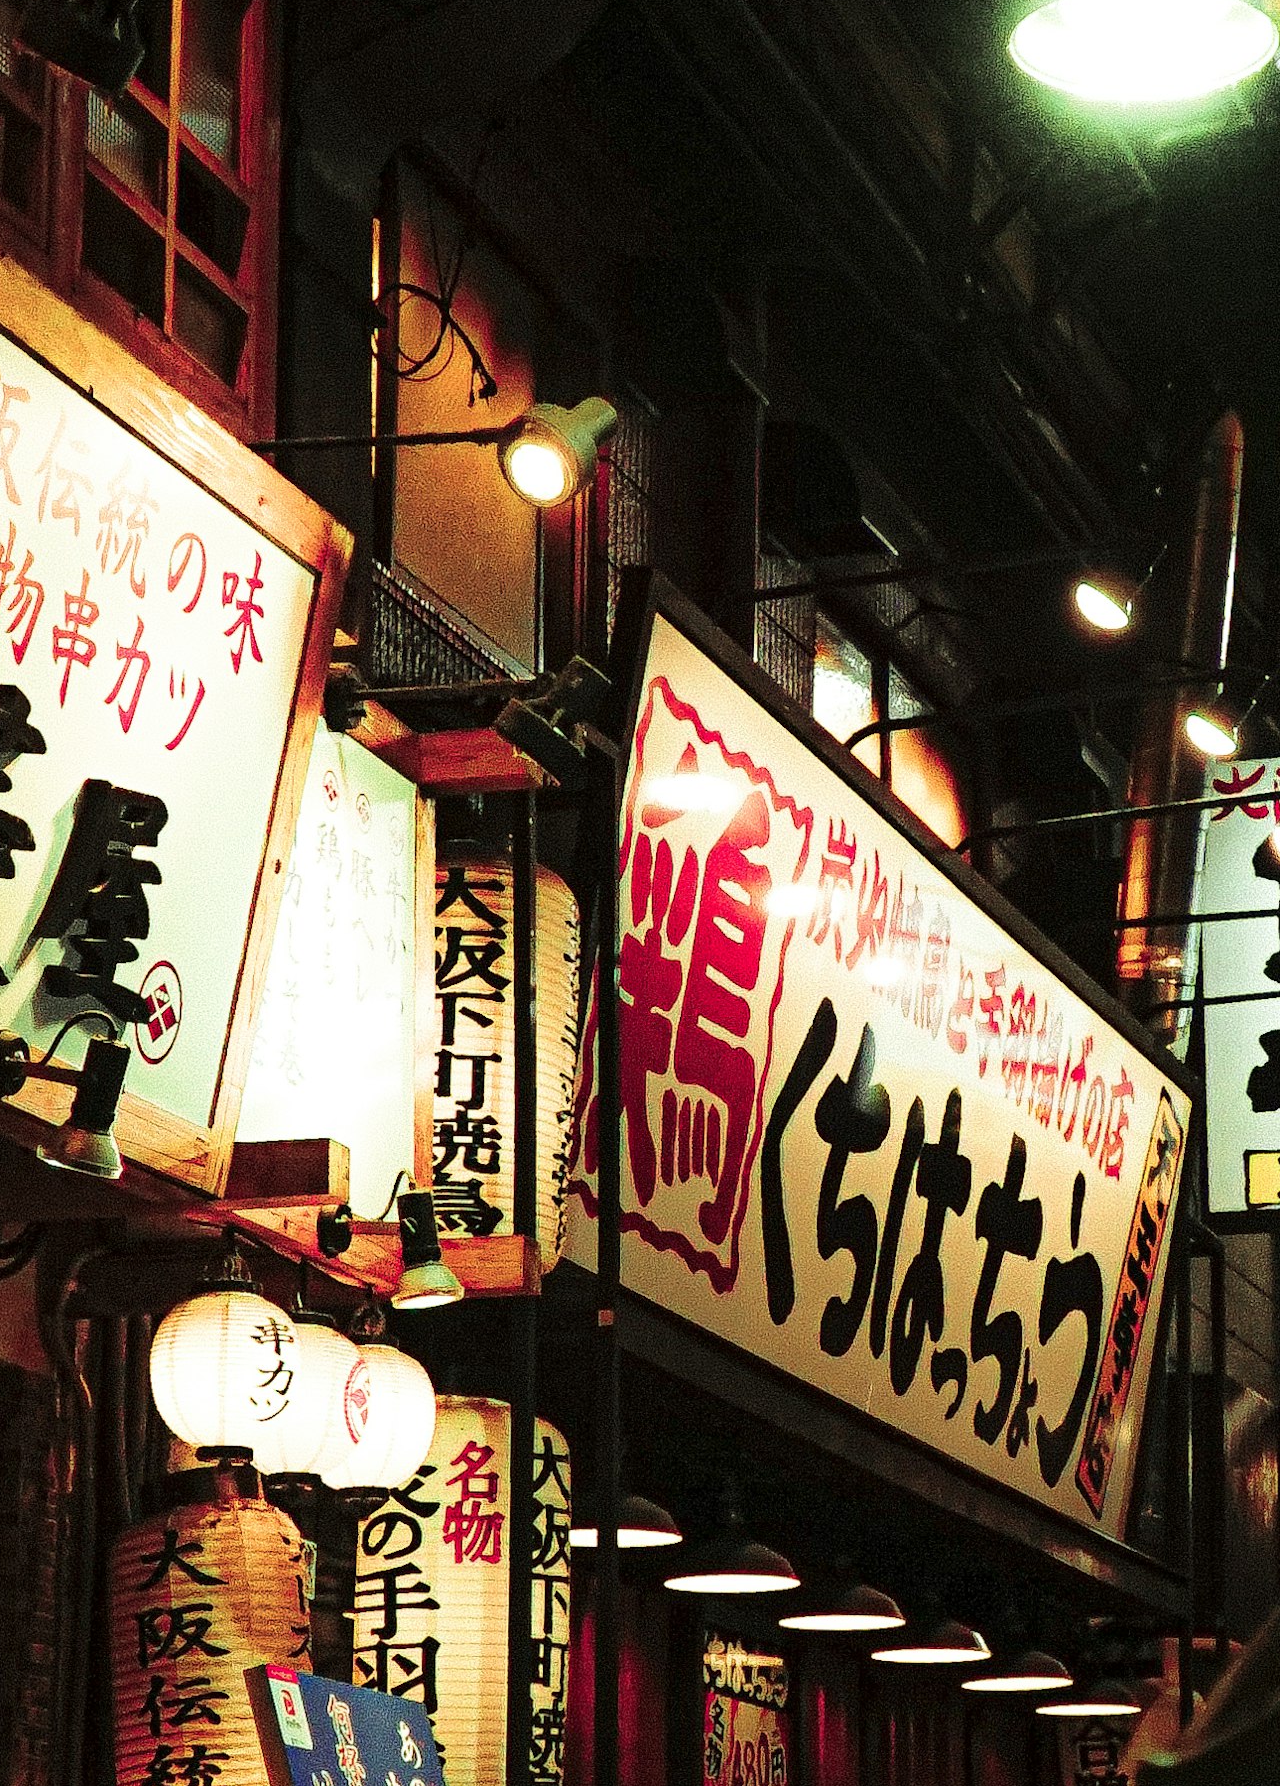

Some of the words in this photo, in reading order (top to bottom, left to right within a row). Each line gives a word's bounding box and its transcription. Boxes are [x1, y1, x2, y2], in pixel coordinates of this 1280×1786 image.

[250, 1317, 294, 1422] 串カツ
[442, 1440, 506, 1564] 名物
